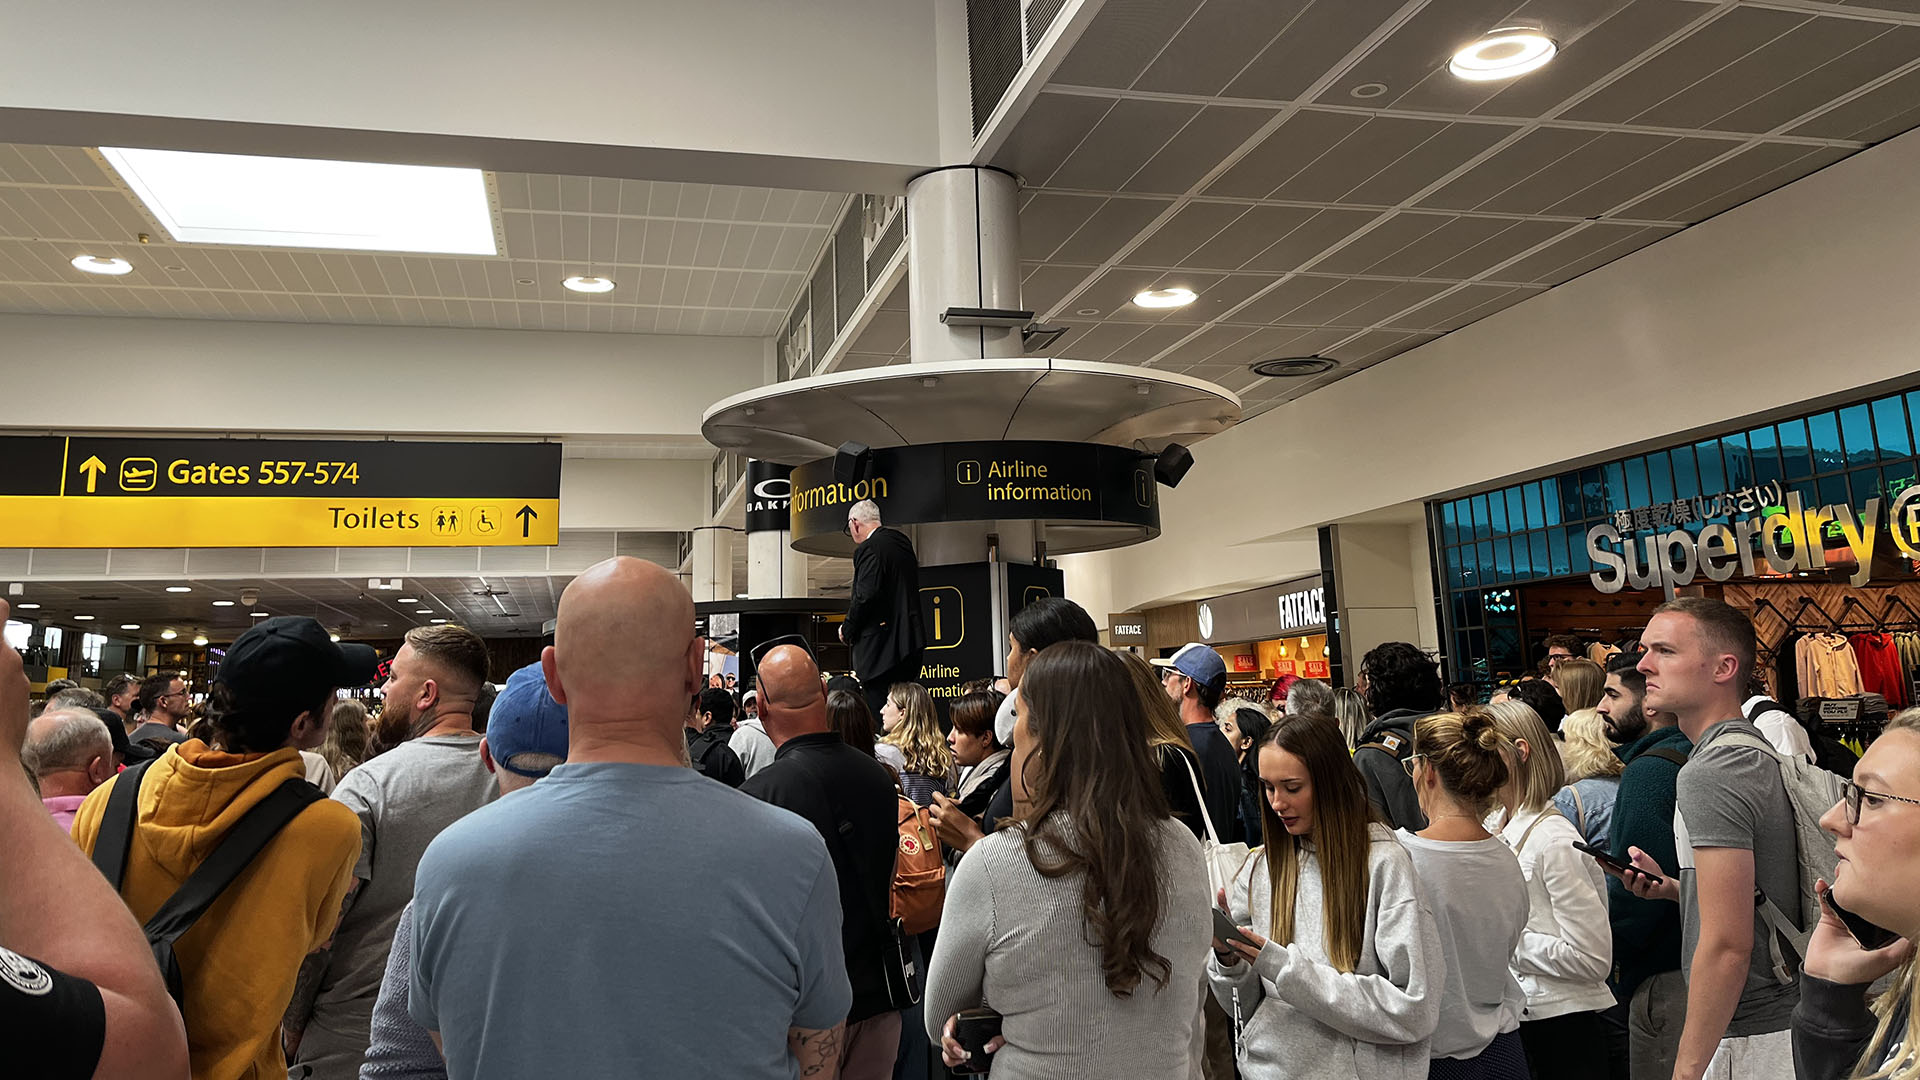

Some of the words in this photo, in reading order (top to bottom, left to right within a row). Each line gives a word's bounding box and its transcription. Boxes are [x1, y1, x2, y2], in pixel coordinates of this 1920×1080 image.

[168, 459, 250, 484] Gates
[258, 461, 360, 485] 557-574
[988, 460, 1048, 478] Airline
[988, 482, 1092, 501] information
[328, 507, 419, 529] Toilets
[1278, 587, 1327, 630] FATFACE
[1115, 625, 1142, 635] FATFACE
[920, 664, 960, 679] Airline
